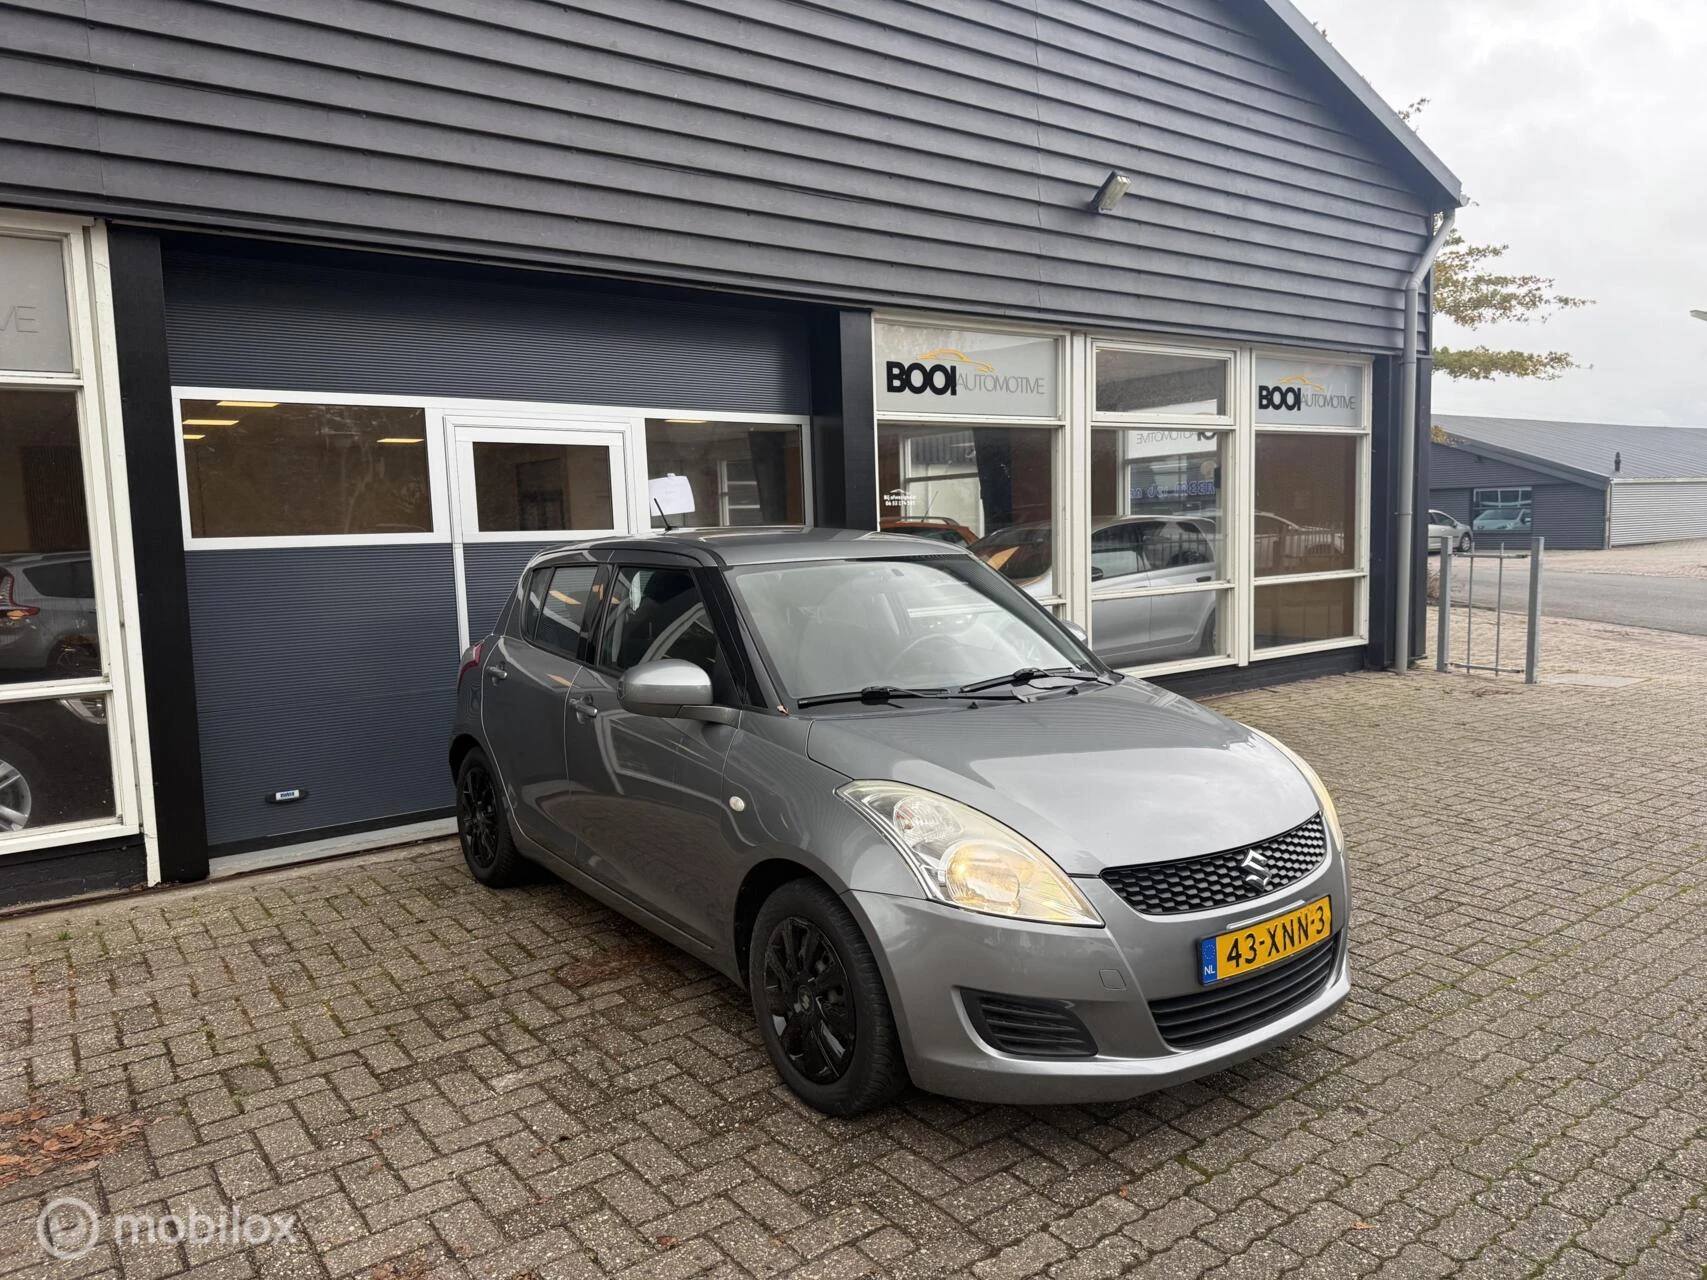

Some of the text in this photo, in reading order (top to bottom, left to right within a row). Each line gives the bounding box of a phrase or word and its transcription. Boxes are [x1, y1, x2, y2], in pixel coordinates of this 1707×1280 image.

[887, 361, 1045, 396] BOOI AUTOMOTIVE
[1259, 385, 1357, 411] BOOI AUTOMOTIVE
[1227, 905, 1325, 968] 43-XNN-3
[1204, 965, 1216, 975] NL
